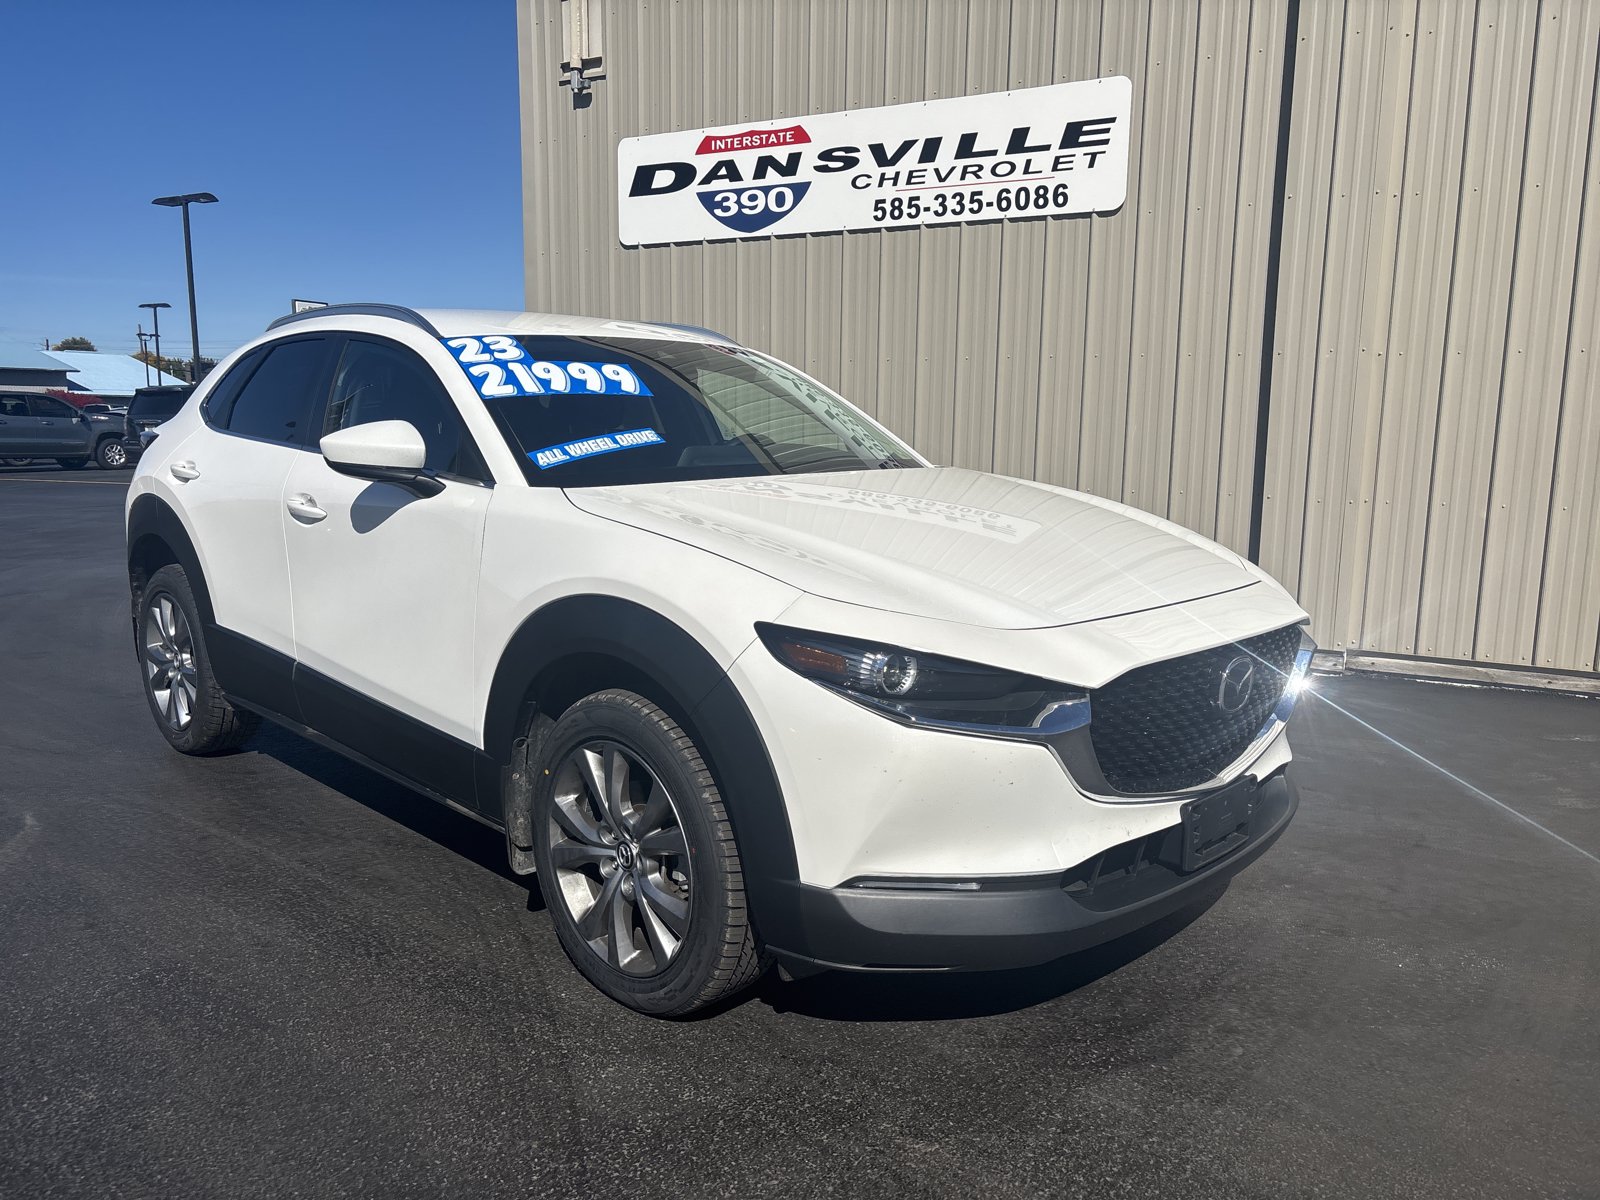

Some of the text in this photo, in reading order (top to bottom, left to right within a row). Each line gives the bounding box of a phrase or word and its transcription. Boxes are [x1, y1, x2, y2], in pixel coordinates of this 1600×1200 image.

[711, 131, 795, 150] INTERSTATE
[850, 150, 1107, 190] CHEVROLET
[713, 186, 794, 217] 390
[872, 183, 1069, 221] 585-335-6086
[447, 336, 525, 363] 23
[468, 361, 641, 396] 21999
[536, 430, 661, 466] ALL WHEEL DRIVE
